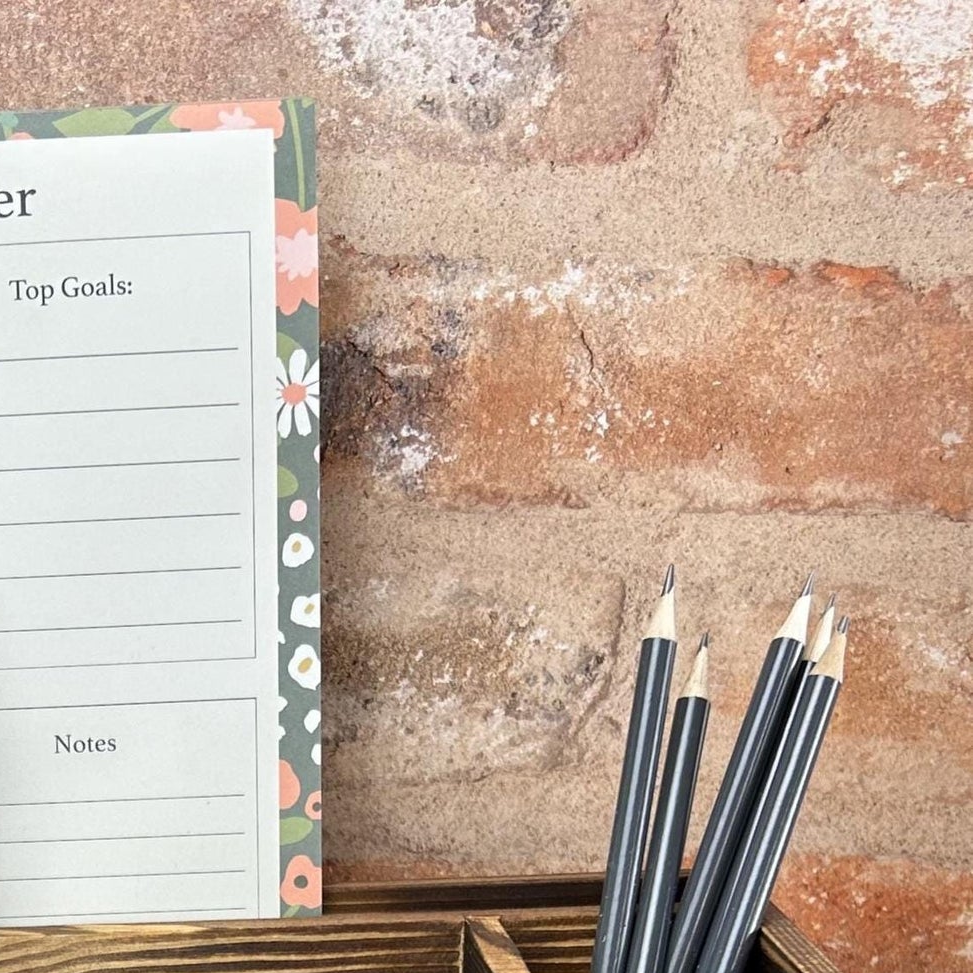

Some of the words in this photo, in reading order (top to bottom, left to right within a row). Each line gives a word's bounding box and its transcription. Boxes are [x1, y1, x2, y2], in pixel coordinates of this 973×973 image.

[9, 280, 54, 305] Top
[62, 274, 131, 297] Goals:
[56, 735, 116, 753] Notes
